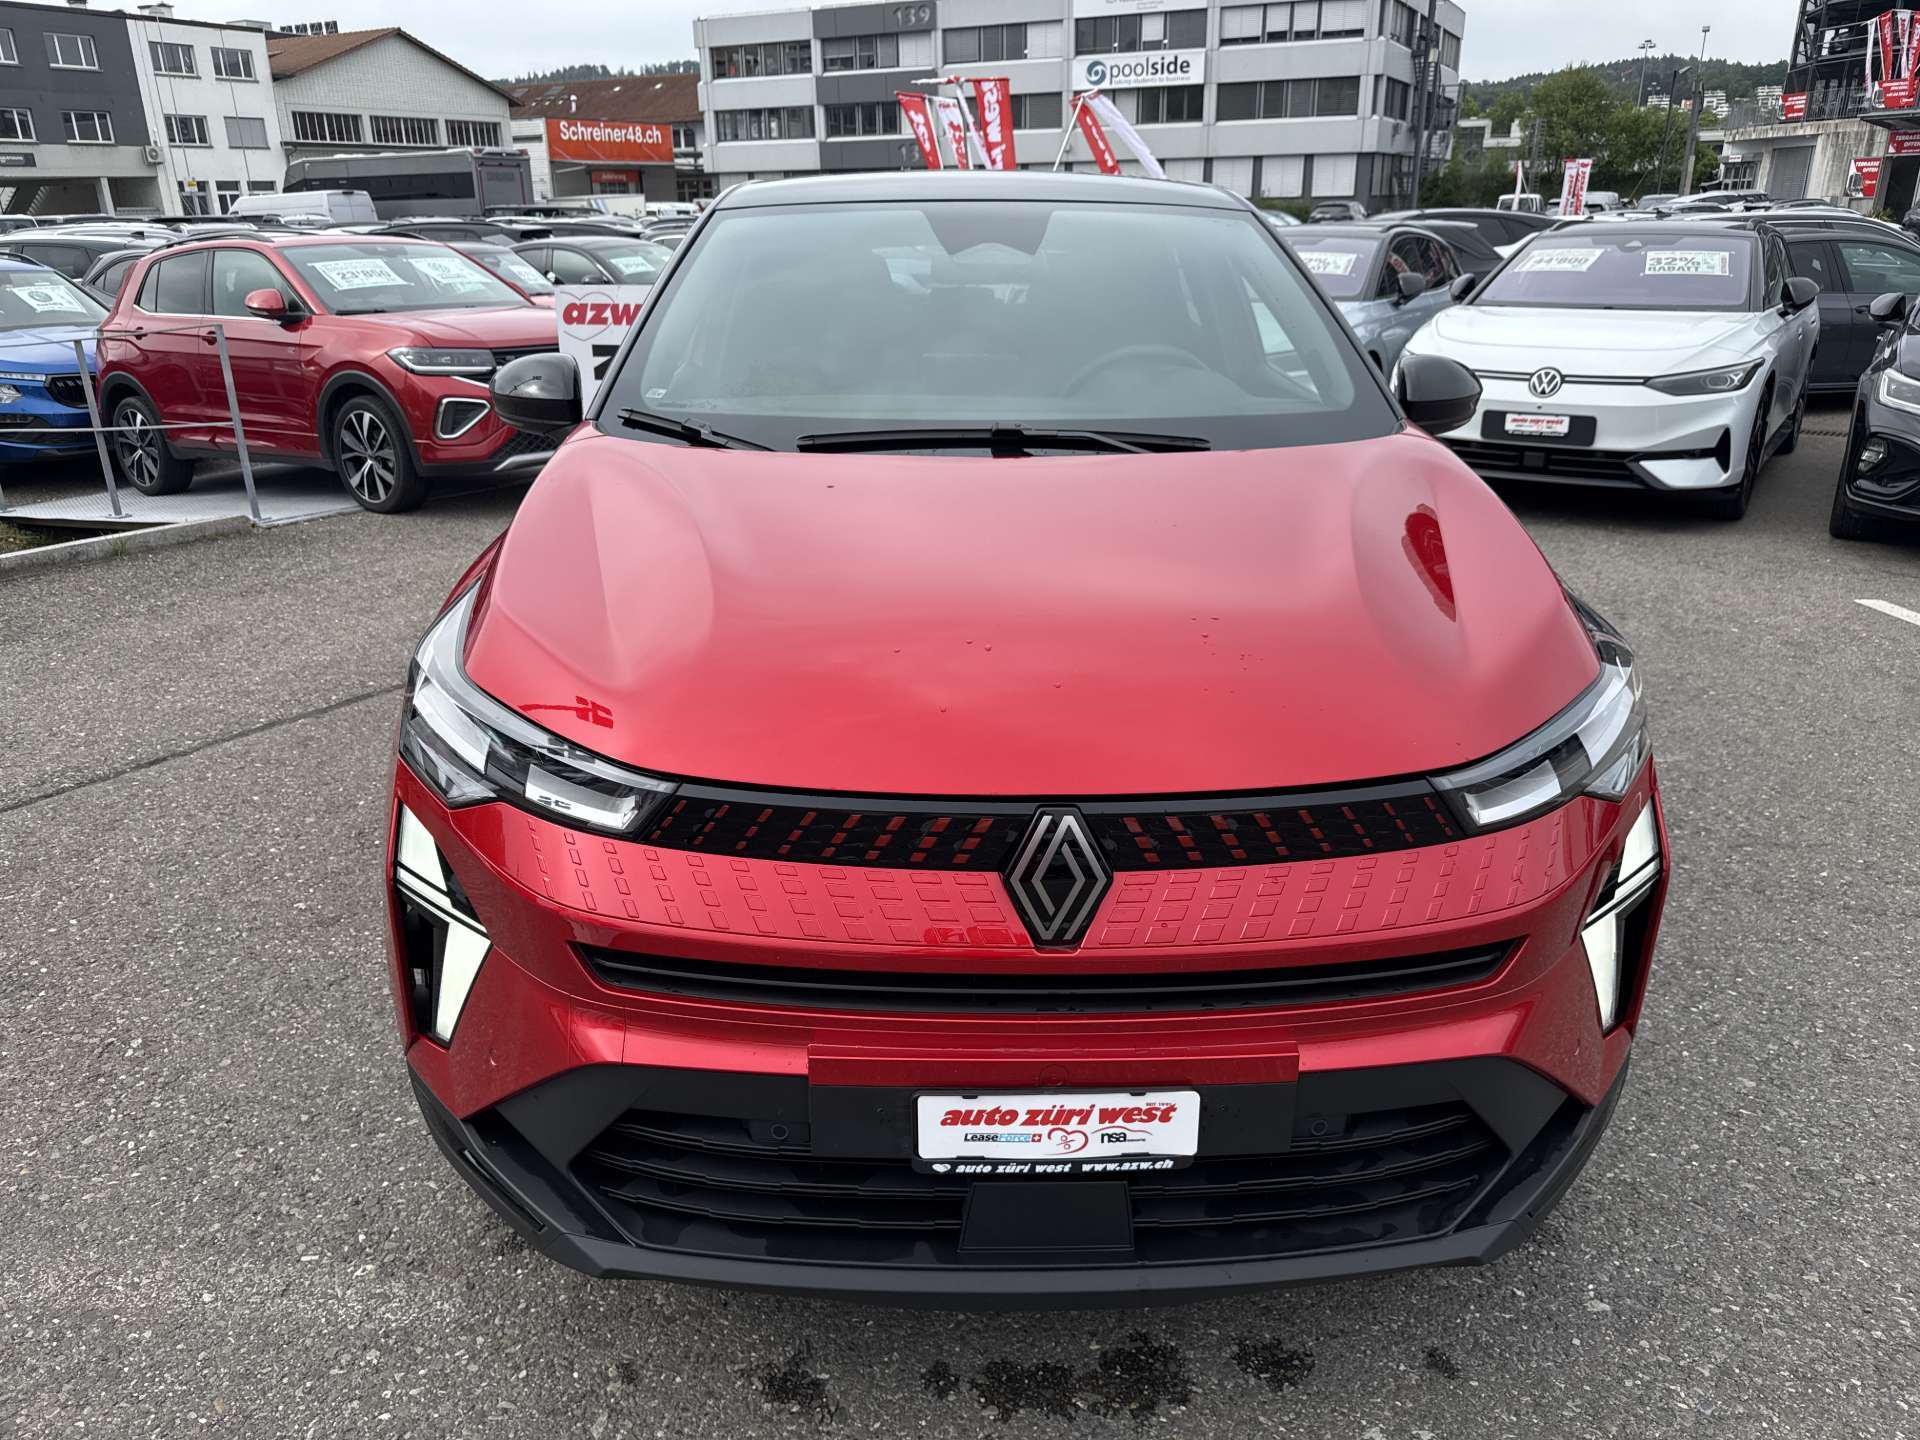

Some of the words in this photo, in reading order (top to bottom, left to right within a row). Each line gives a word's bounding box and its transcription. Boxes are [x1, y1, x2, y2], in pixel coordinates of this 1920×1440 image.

[893, 4, 931, 26] 139
[1109, 55, 1190, 85] poolside
[559, 120, 662, 144] Schreiner48.ch
[1649, 256, 1701, 266] 32%
[562, 302, 643, 326] azw
[940, 1105, 1019, 1127] auto
[1019, 1103, 1096, 1126] züri
[1098, 1103, 1177, 1124] west
[1100, 1132, 1127, 1144] nsa
[955, 1163, 993, 1174] auto
[995, 1162, 1032, 1174] züri
[1034, 1162, 1072, 1173] west
[1081, 1159, 1175, 1172] www.azw.ch
